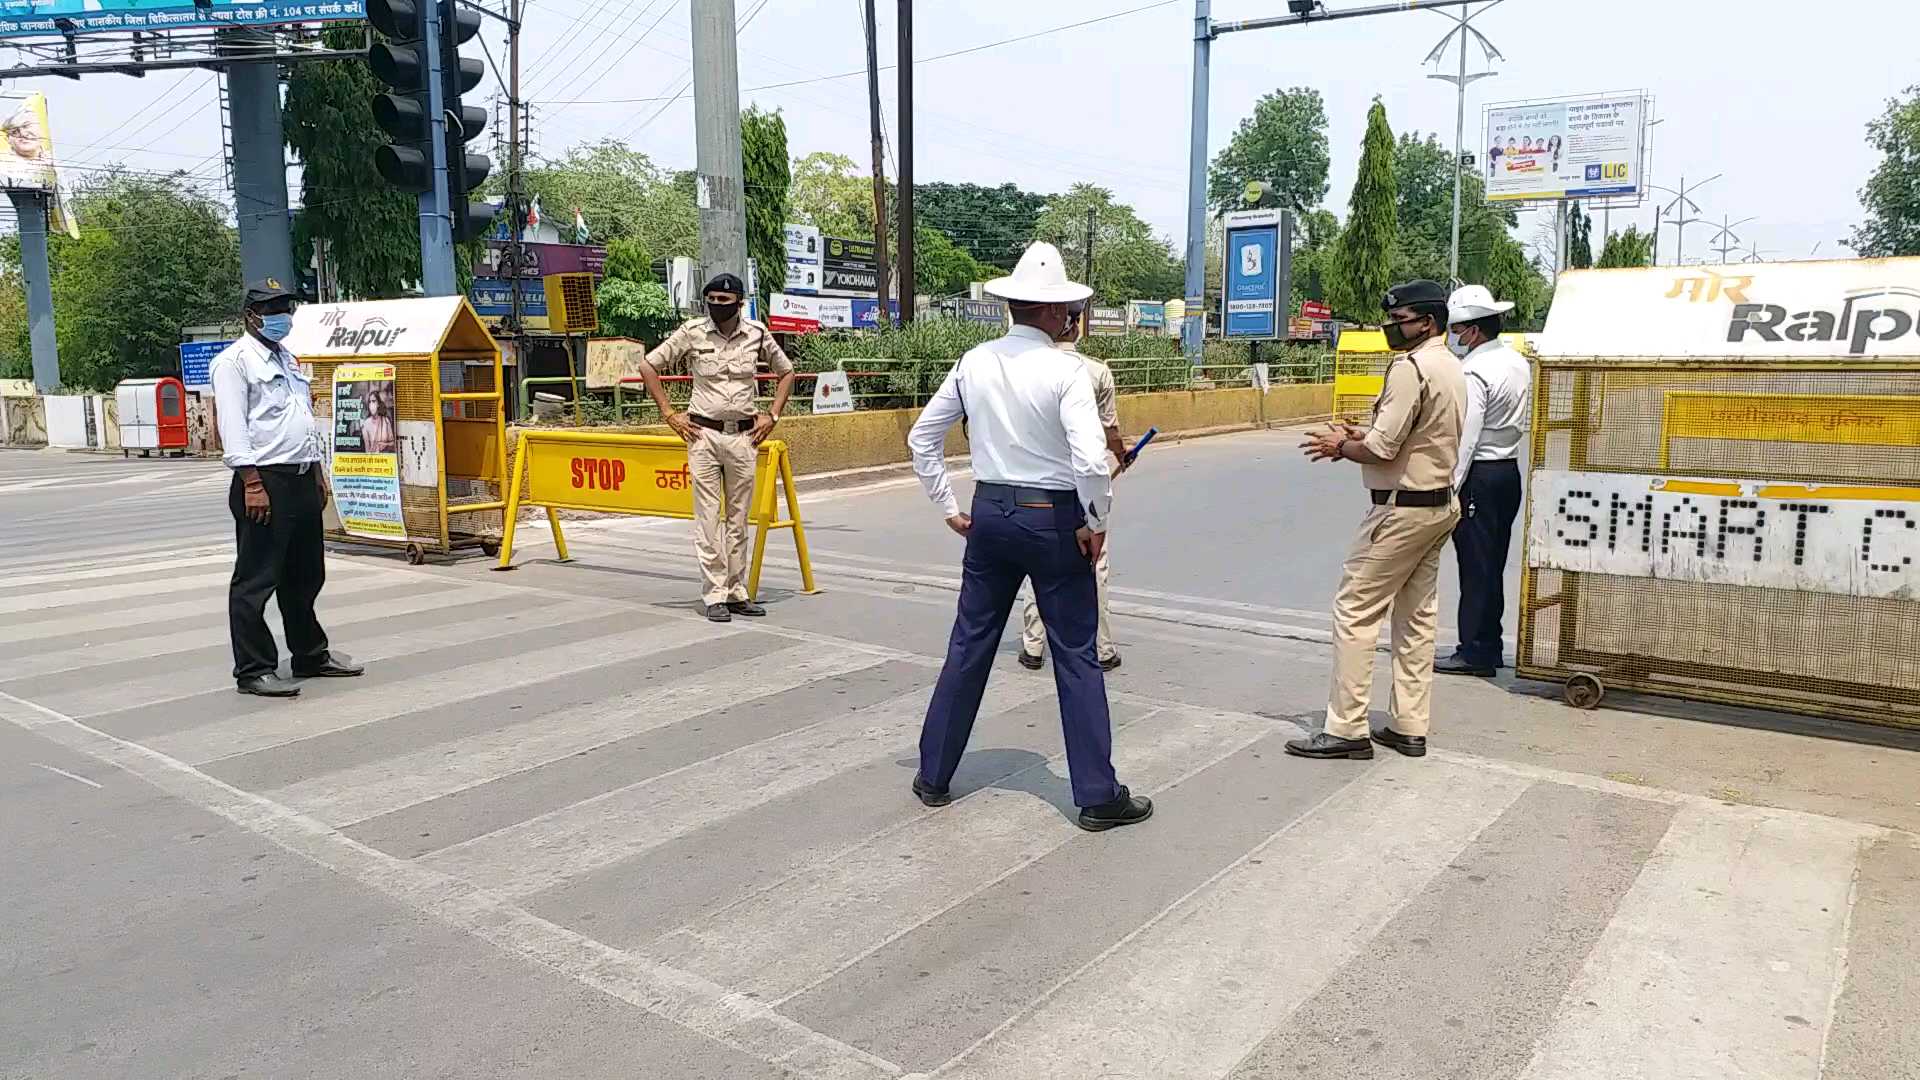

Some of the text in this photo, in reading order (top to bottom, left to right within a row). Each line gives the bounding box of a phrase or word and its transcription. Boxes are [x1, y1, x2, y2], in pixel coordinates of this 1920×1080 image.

[124, 13, 146, 26] जिला
[235, 8, 253, 20] टोल
[255, 6, 267, 19] फ्री
[284, 6, 301, 17] 104
[304, 5, 316, 15] पर
[319, 2, 341, 15] संपर्क
[1604, 163, 1626, 178] LIC
[837, 273, 877, 288] YOKOHAMA
[1664, 270, 1755, 303] मोर
[1726, 294, 1920, 355] Raip
[571, 457, 626, 491] STOP
[1556, 487, 1829, 566] SMART
